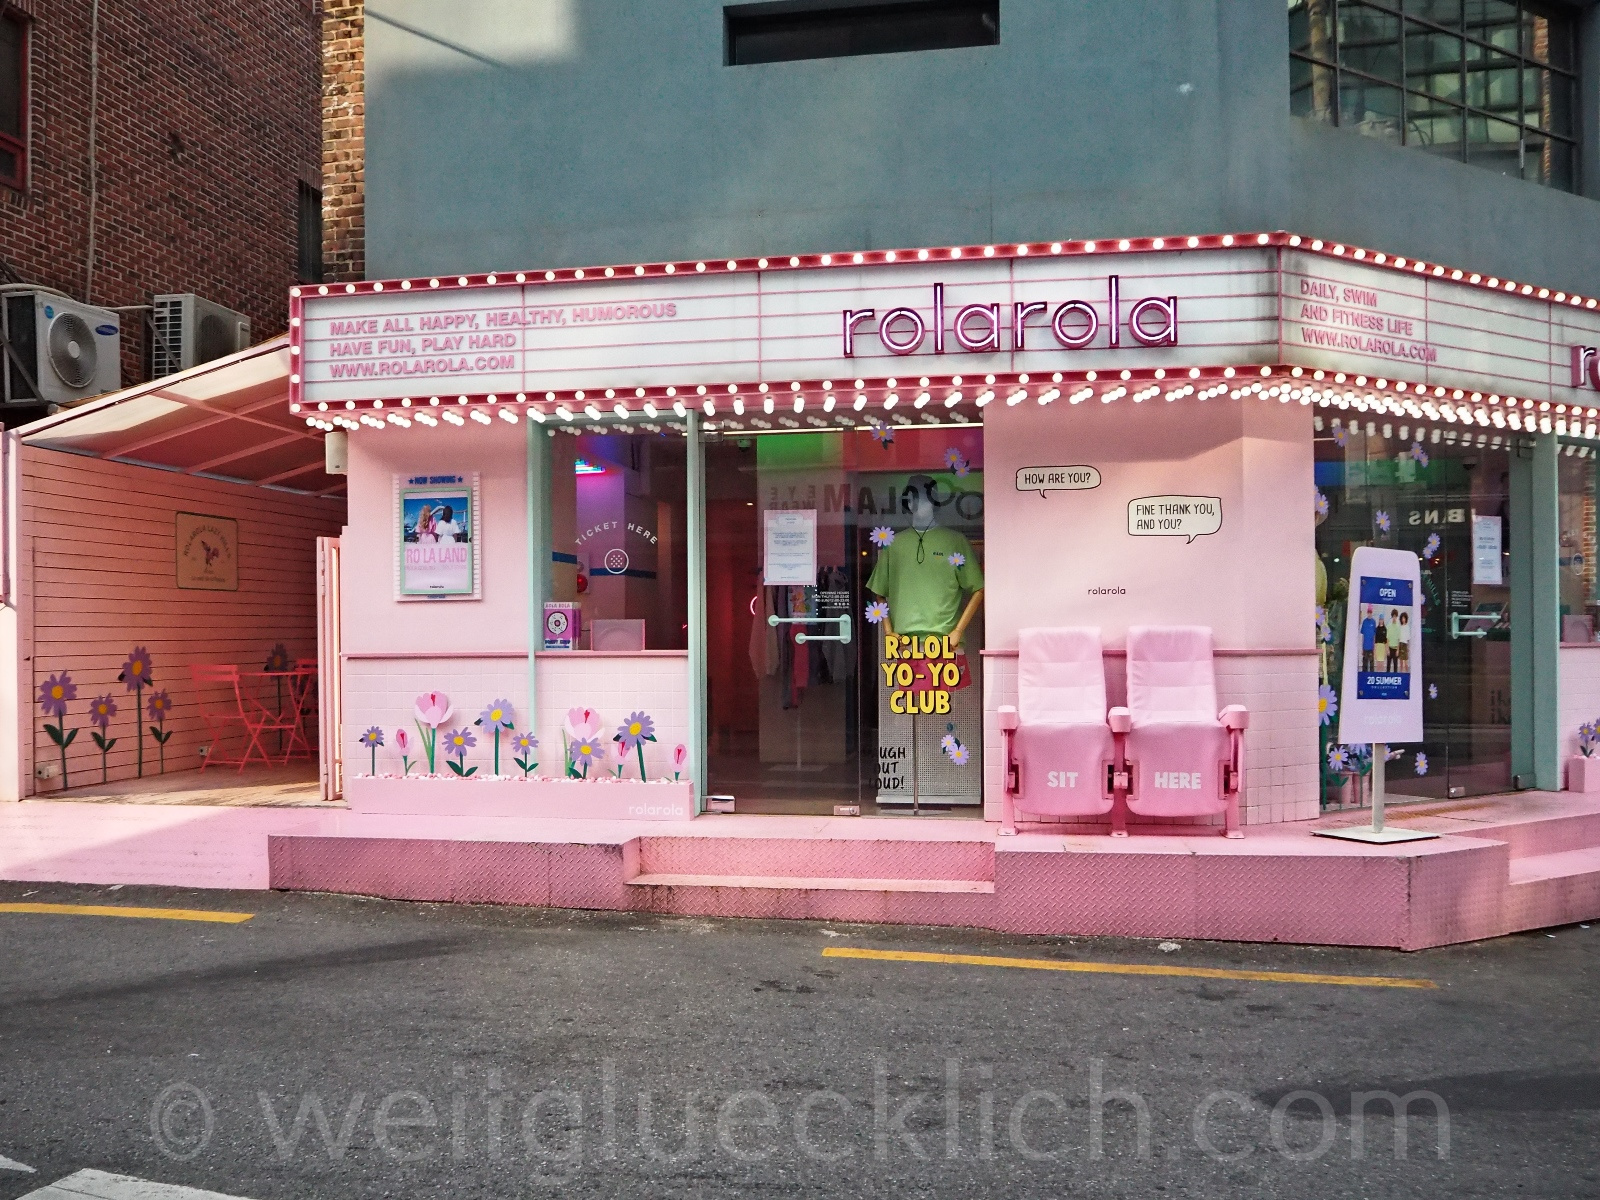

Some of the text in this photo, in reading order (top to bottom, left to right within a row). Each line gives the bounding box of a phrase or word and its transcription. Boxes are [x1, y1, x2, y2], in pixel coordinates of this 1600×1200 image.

[1300, 279, 1378, 308] DAILY, SWIM
[330, 302, 677, 335] MAKE ALL HAPPY, HEALTHY, HUMOROUS
[843, 275, 1178, 358] rolarola
[1301, 303, 1413, 336] AND FITNESS LIFE
[330, 332, 516, 357] HAVE FUN, PLAY HARD
[1301, 326, 1437, 362] WWW.ROLAROLA.COM
[330, 354, 515, 377] WWW.ROLAROLA.COM
[1024, 472, 1091, 484] HOW ARE YOU?
[1136, 503, 1215, 516] FINE THANK YOU,
[574, 521, 658, 546] TICKET HERE
[1136, 518, 1182, 530] AND YOU?
[406, 546, 468, 563] RO LA LAND
[1087, 586, 1126, 595] rolarola
[1379, 587, 1396, 598] OPEN
[880, 662, 961, 688] YO-YO
[1367, 676, 1402, 685] 20 SUMMER
[889, 689, 951, 715] CLUB
[878, 746, 906, 759] UGH
[1046, 771, 1201, 790] SIT HERE
[628, 802, 684, 816] rolarola
